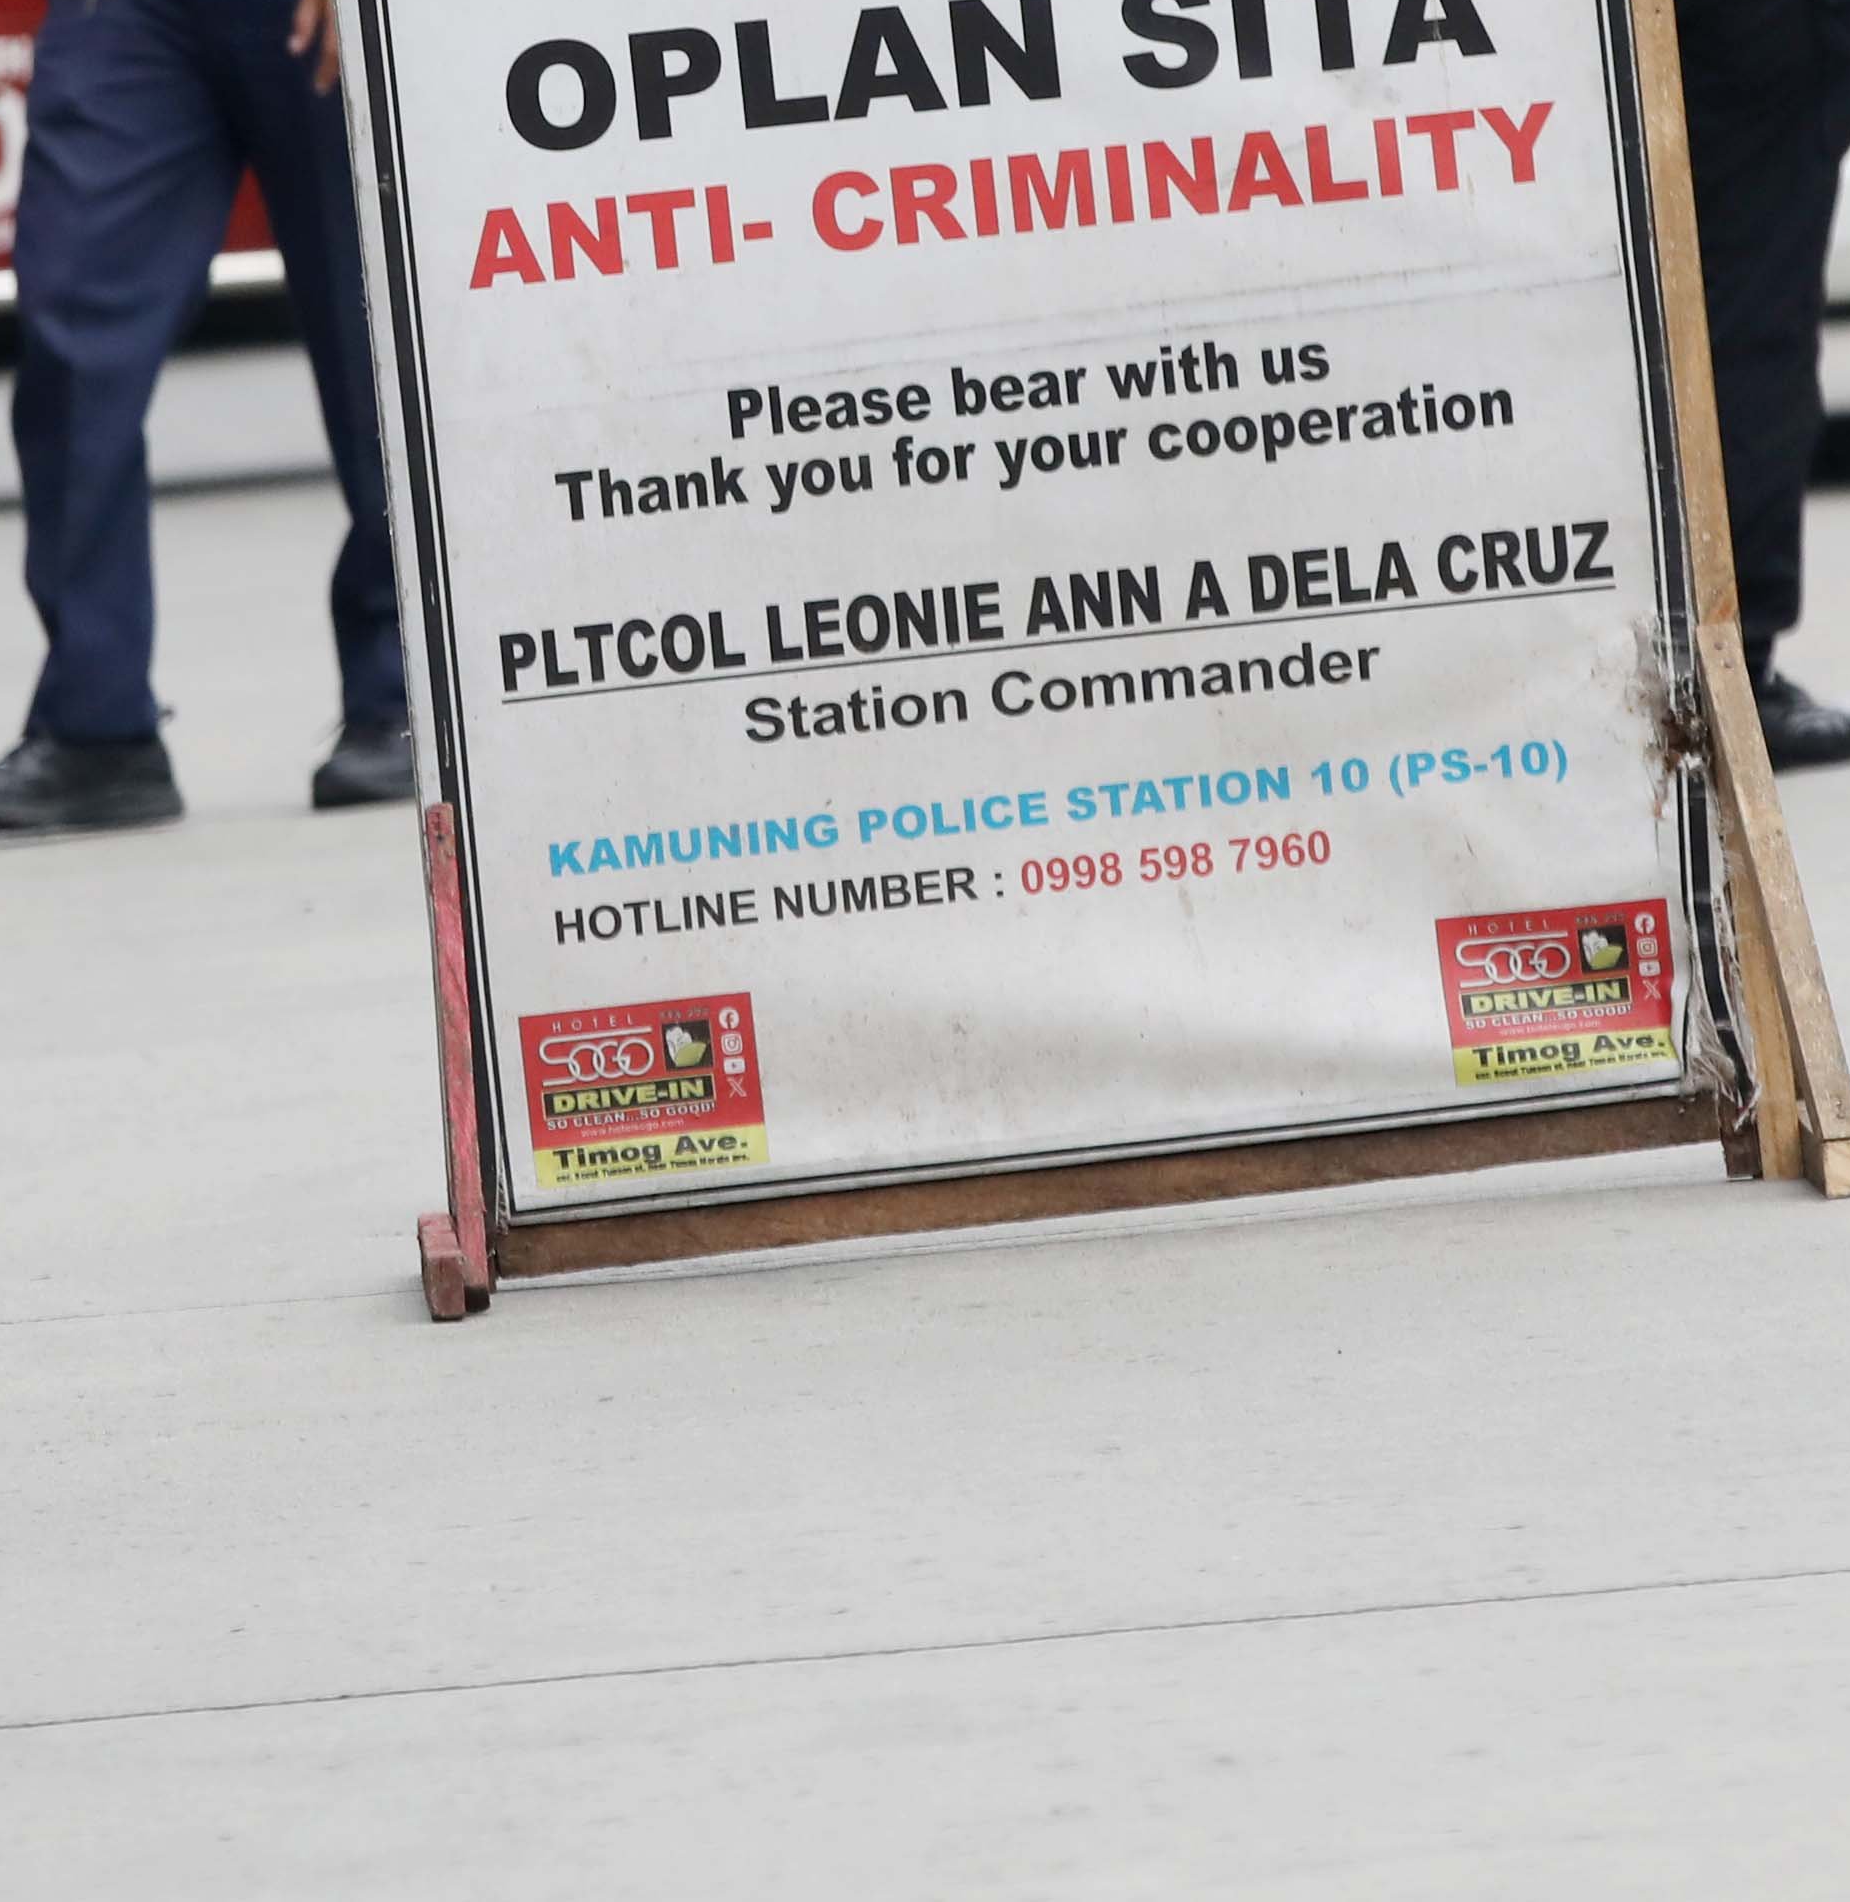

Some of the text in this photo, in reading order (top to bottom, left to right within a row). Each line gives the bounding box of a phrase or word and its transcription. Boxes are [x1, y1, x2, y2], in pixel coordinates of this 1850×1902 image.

[470, 102, 1552, 289] ANTI- CRIMINALITY
[728, 342, 1329, 439] Please bear with us
[555, 384, 1513, 520] Thank you for your cooperation
[500, 521, 1613, 692] PLTCOL LEONIE ANN A DELA CRUZ
[746, 642, 1379, 742] Station Commander
[550, 741, 1567, 876] KAMUNING POLICE STATION 10 (PS-10)
[555, 890, 758, 944] HOTLINE
[774, 868, 977, 919] NUMBER
[1021, 853, 1122, 896] 0998
[1141, 843, 1212, 881] 598
[1230, 831, 1330, 869] 7960
[1468, 919, 1549, 936] HOTEL
[1455, 930, 1571, 989] SOGO
[552, 1014, 634, 1033] HOTEL
[1465, 1017, 1487, 1030] SO
[1583, 1005, 1632, 1018] GOOD!
[1470, 982, 1621, 1015] DRIVE-IN
[539, 1027, 655, 1087] SOGO
[1473, 1033, 1666, 1068] Timog Ave.
[547, 1119, 568, 1131] SO
[666, 1102, 716, 1116] GOOD!
[554, 1079, 705, 1114] DRIVE-IN
[553, 1133, 748, 1169] Timog Ave.
